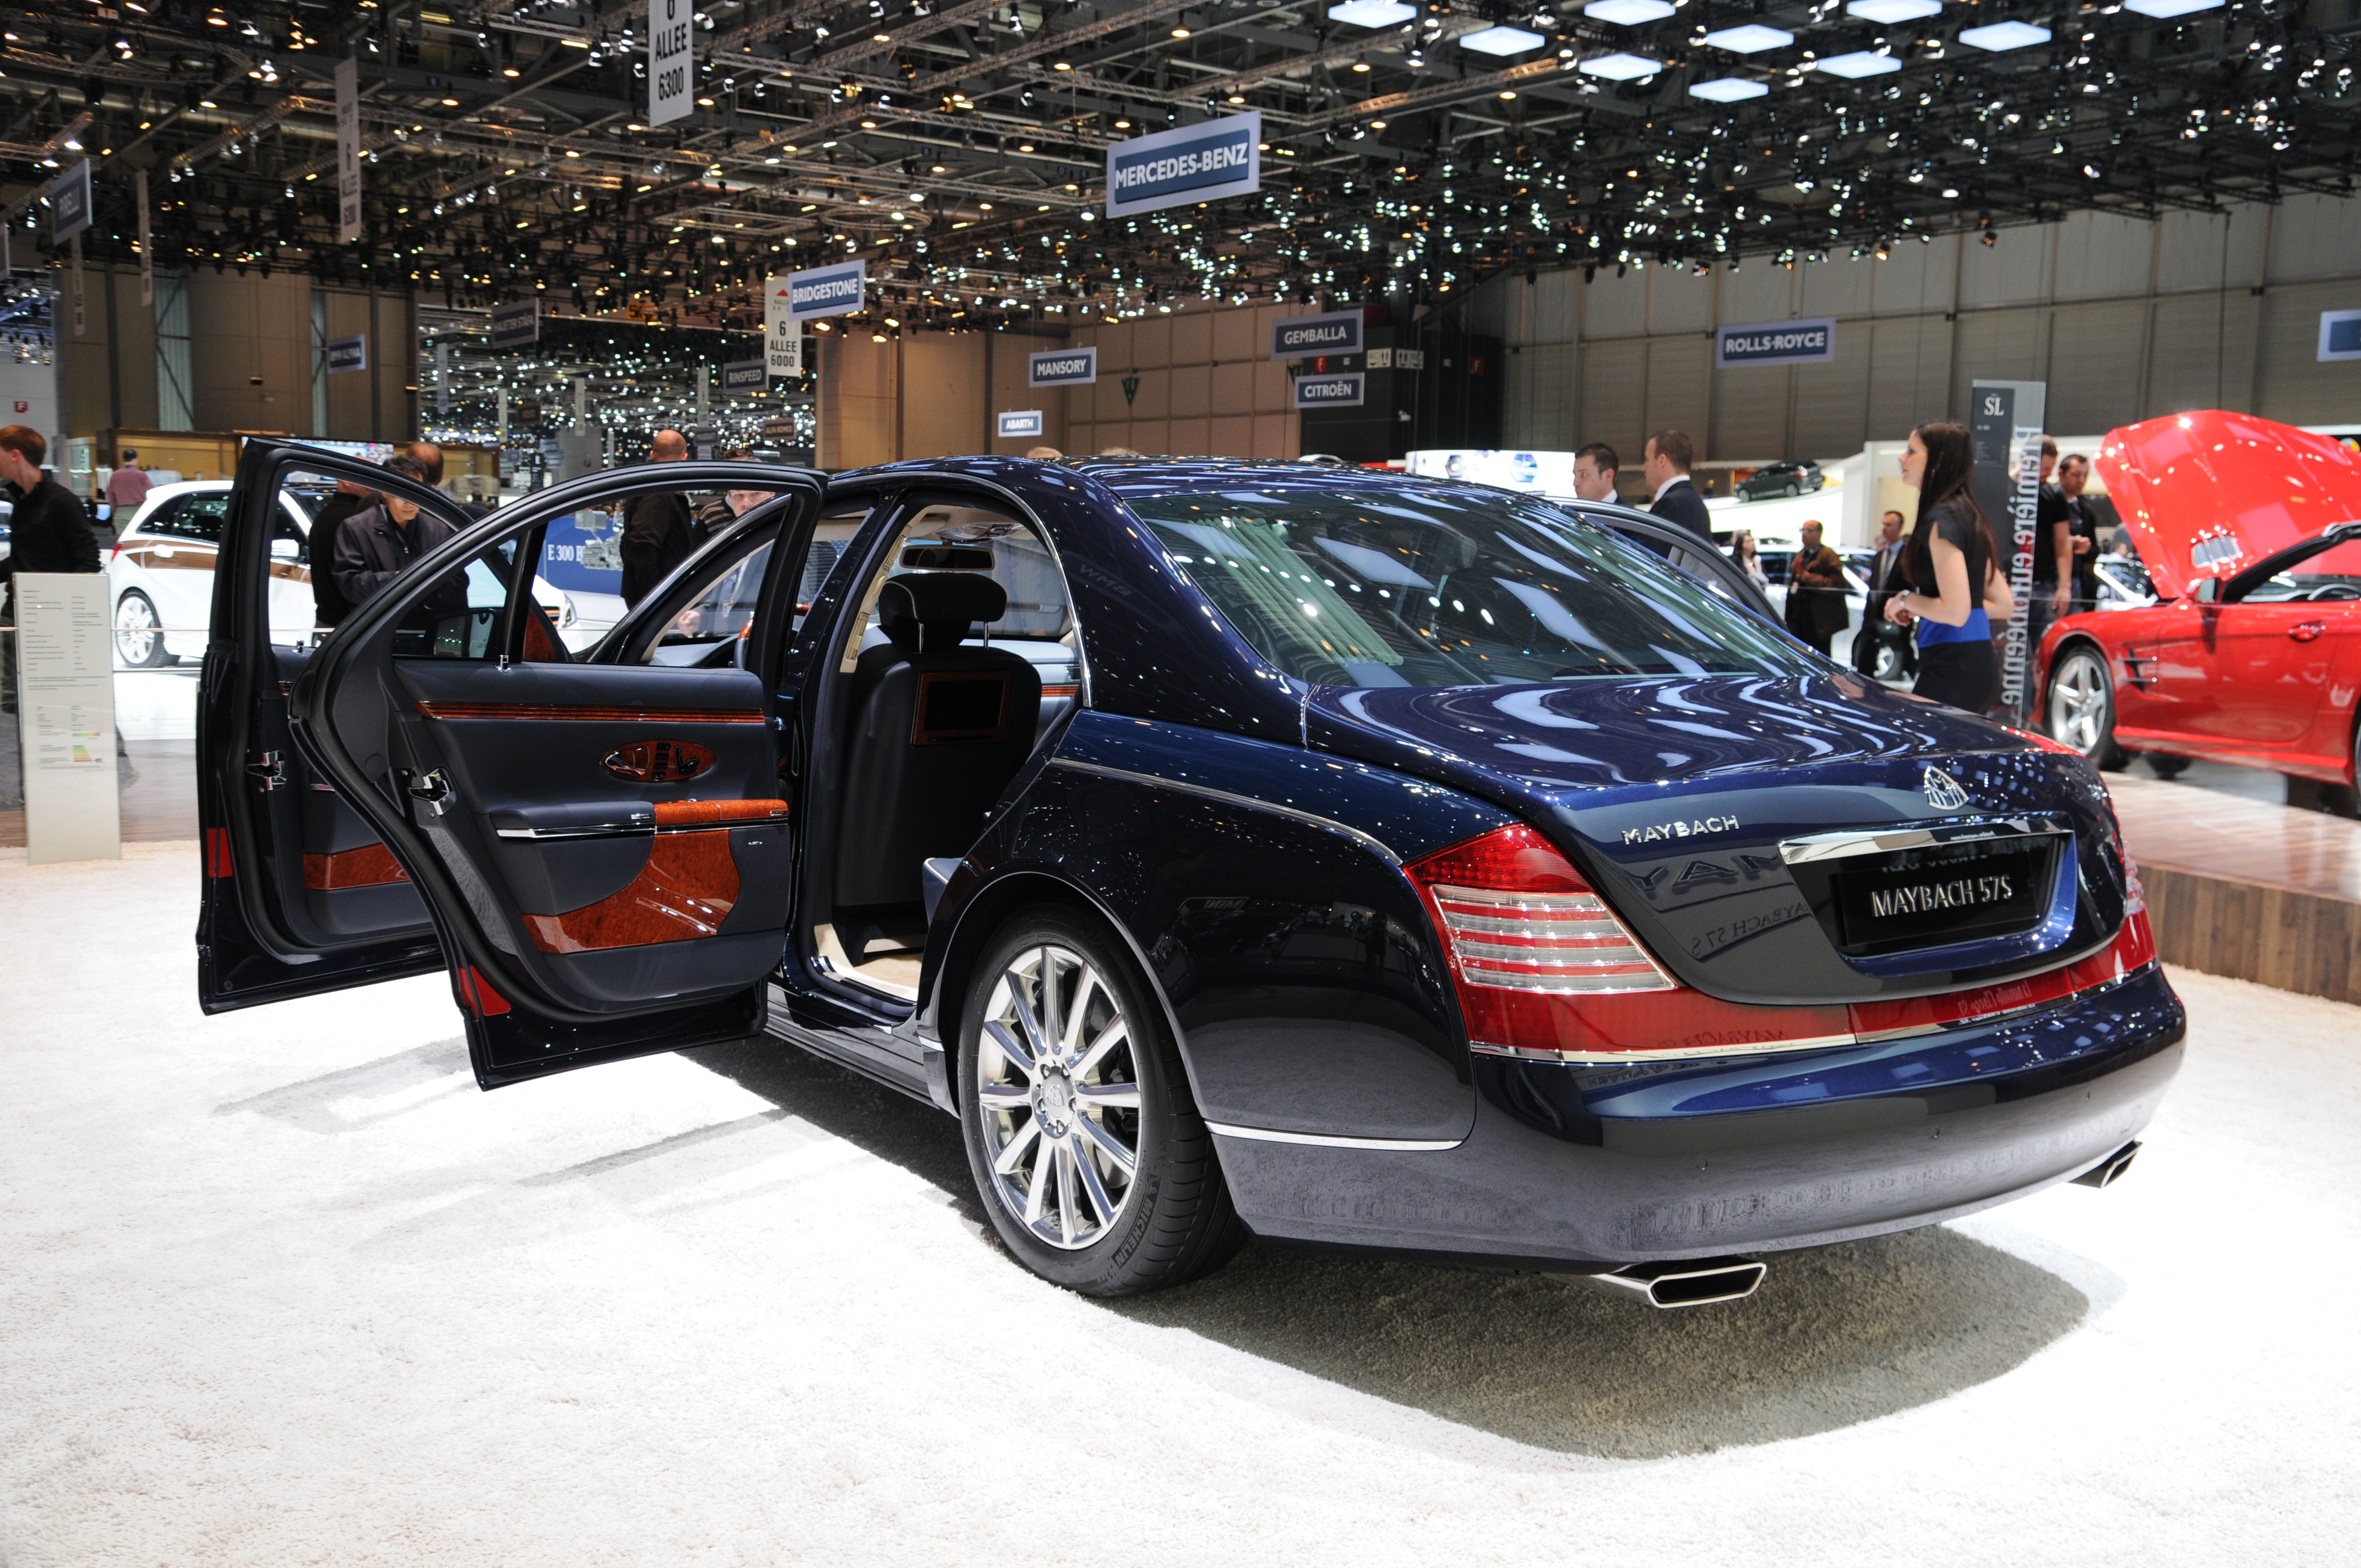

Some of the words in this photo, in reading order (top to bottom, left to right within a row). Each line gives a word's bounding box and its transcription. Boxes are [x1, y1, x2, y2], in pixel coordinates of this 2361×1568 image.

[655, 23, 687, 62] ALLEE
[659, 66, 684, 101] 6300
[1115, 142, 1248, 190] MERCEDES-BENZ
[792, 277, 858, 304] BRIDGESTONE
[779, 320, 786, 336] 6
[1284, 325, 1347, 345] GEMBALLA
[769, 339, 797, 352] ALLEE
[1725, 331, 1825, 353] ROLLS-ROYCE
[771, 354, 795, 367] 6000
[1037, 358, 1087, 376] MANSORY
[728, 369, 762, 384] RINSPEED
[1304, 380, 1352, 398] CITROËN
[1983, 396, 2005, 416] SL
[1005, 418, 1033, 429] ABARTH
[547, 544, 555, 560] E
[556, 545, 575, 561] 300
[1621, 815, 1740, 845] MAYBACH
[1871, 879, 1975, 917] MAYBACH
[1979, 874, 2014, 903] 57S
[1114, 1196, 1155, 1267] MICHELIN
